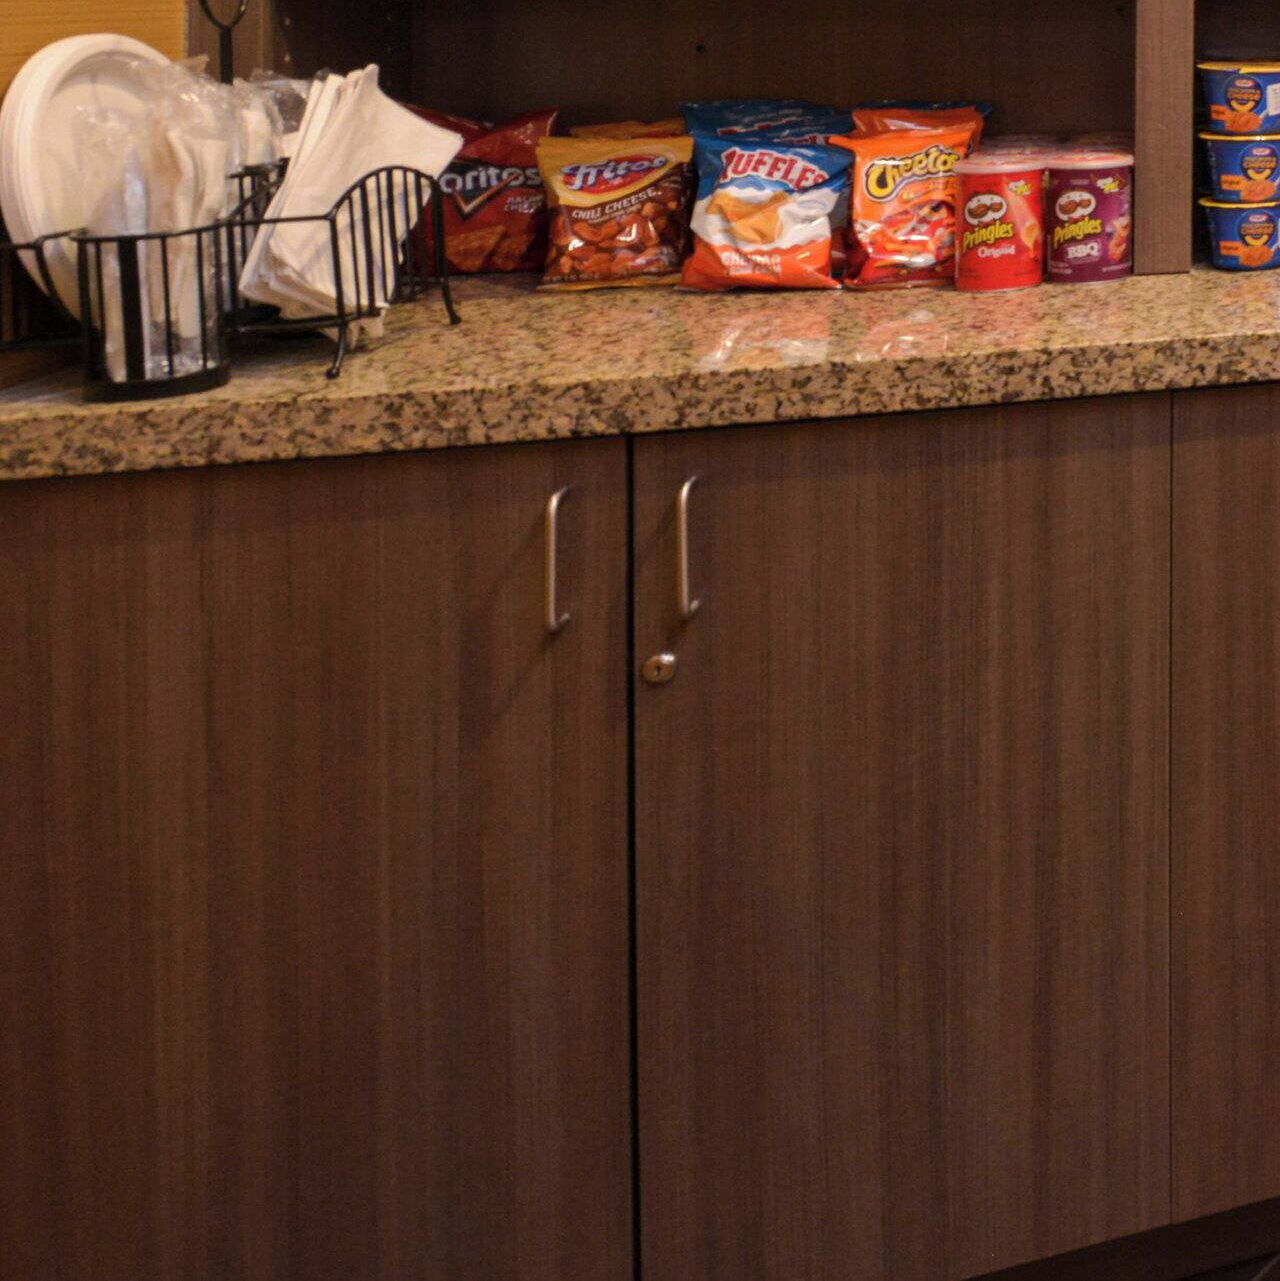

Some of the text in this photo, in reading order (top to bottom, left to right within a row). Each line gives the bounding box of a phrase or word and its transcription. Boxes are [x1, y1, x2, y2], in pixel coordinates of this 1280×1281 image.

[440, 165, 542, 195] oritos
[560, 155, 668, 191] Fritos
[720, 147, 831, 190] RUFFLES
[571, 189, 661, 220] CHILI CHEESE
[961, 217, 1016, 255] Pringles
[1052, 215, 1103, 249] Pringles
[1066, 242, 1100, 260] BBQ
